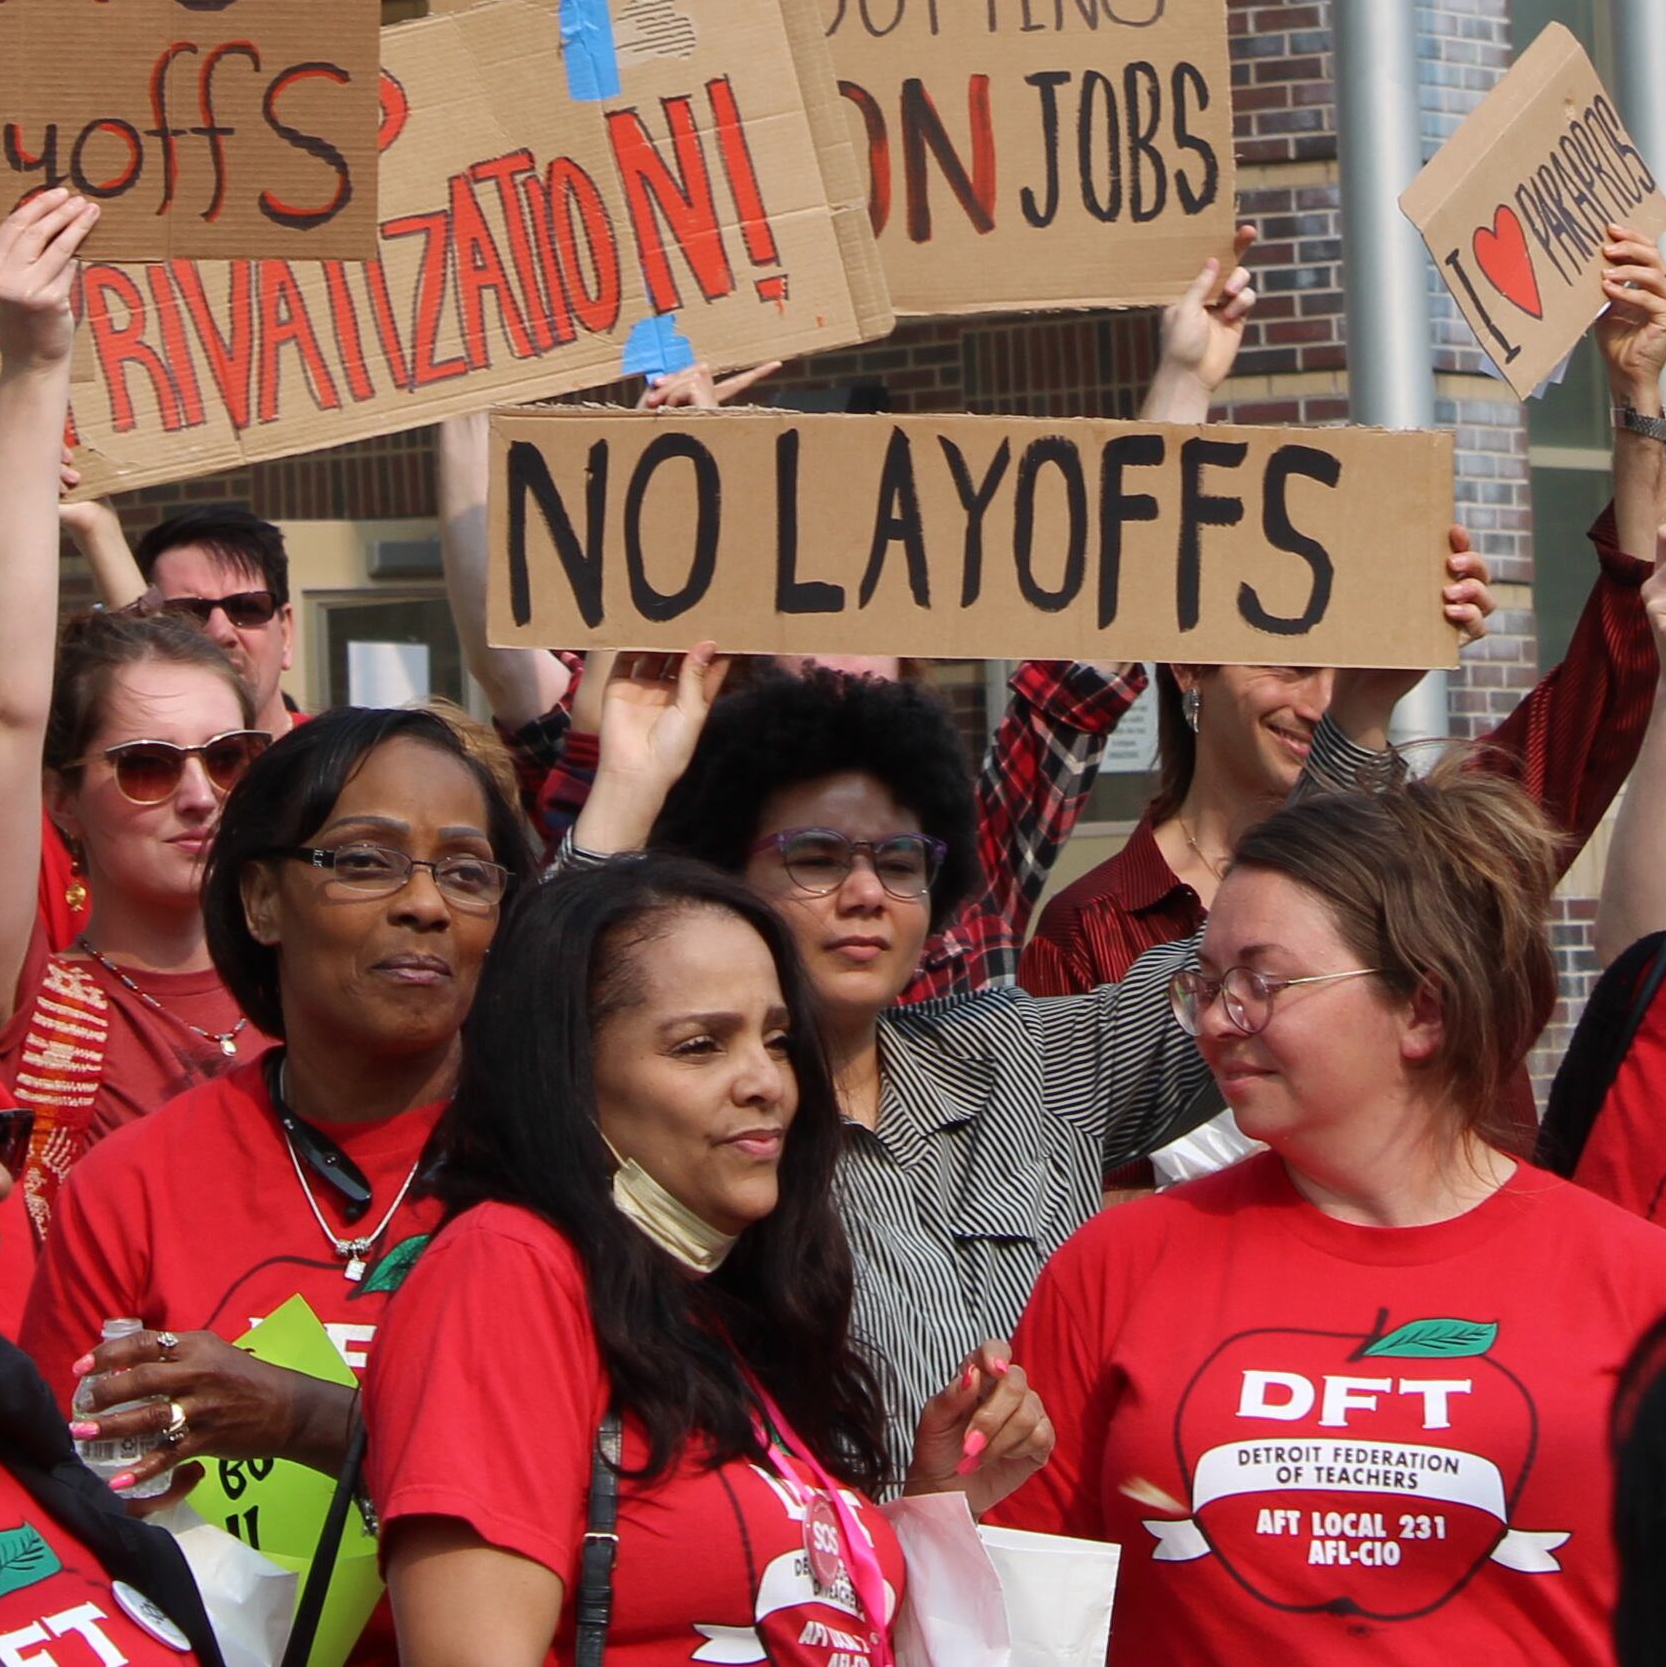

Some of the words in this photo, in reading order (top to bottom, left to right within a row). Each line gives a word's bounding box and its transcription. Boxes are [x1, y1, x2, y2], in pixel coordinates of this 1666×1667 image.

[1021, 61, 1218, 227] JOBS
[1445, 248, 1521, 365] I
[1515, 94, 1656, 287] PARAPROS
[63, 74, 789, 448] RIVATIZATION!
[509, 431, 722, 629] NO
[775, 425, 1342, 635] LAYOFFS
[1235, 1370, 1472, 1429] DFT
[1238, 1446, 1322, 1466] DETROIT
[1333, 1447, 1461, 1475] FEDERATION
[1276, 1466, 1304, 1484] OF
[1315, 1466, 1419, 1490] TEACHERS
[1256, 1509, 1301, 1536] AFT
[1311, 1511, 1387, 1538] LOCAL
[1398, 1514, 1446, 1540] 231
[1308, 1540, 1401, 1566] AFL-CIO
